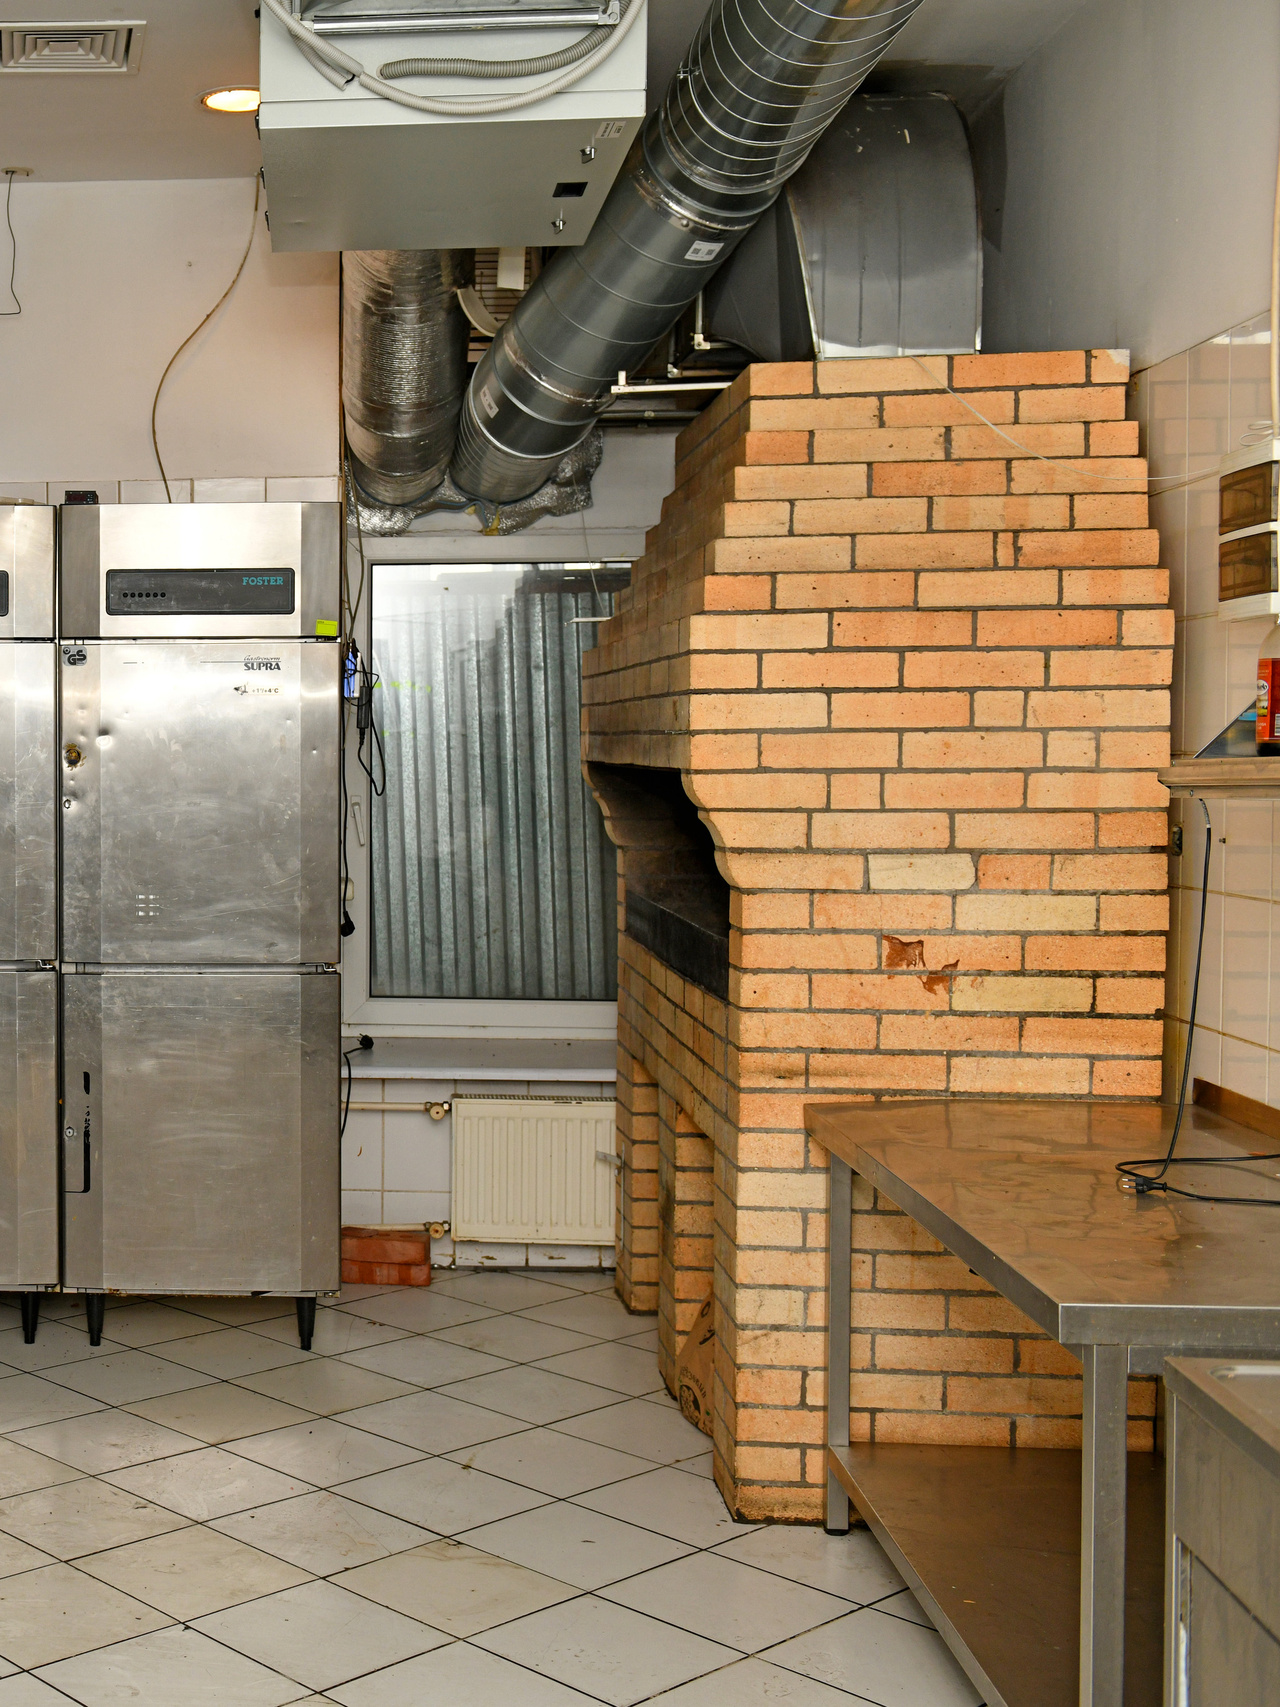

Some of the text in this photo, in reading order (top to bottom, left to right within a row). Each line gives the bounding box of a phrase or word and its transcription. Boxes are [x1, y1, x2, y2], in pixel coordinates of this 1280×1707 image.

[242, 577, 284, 586] FOSTER
[67, 649, 87, 666] GS
[243, 662, 281, 671] SUPRA
